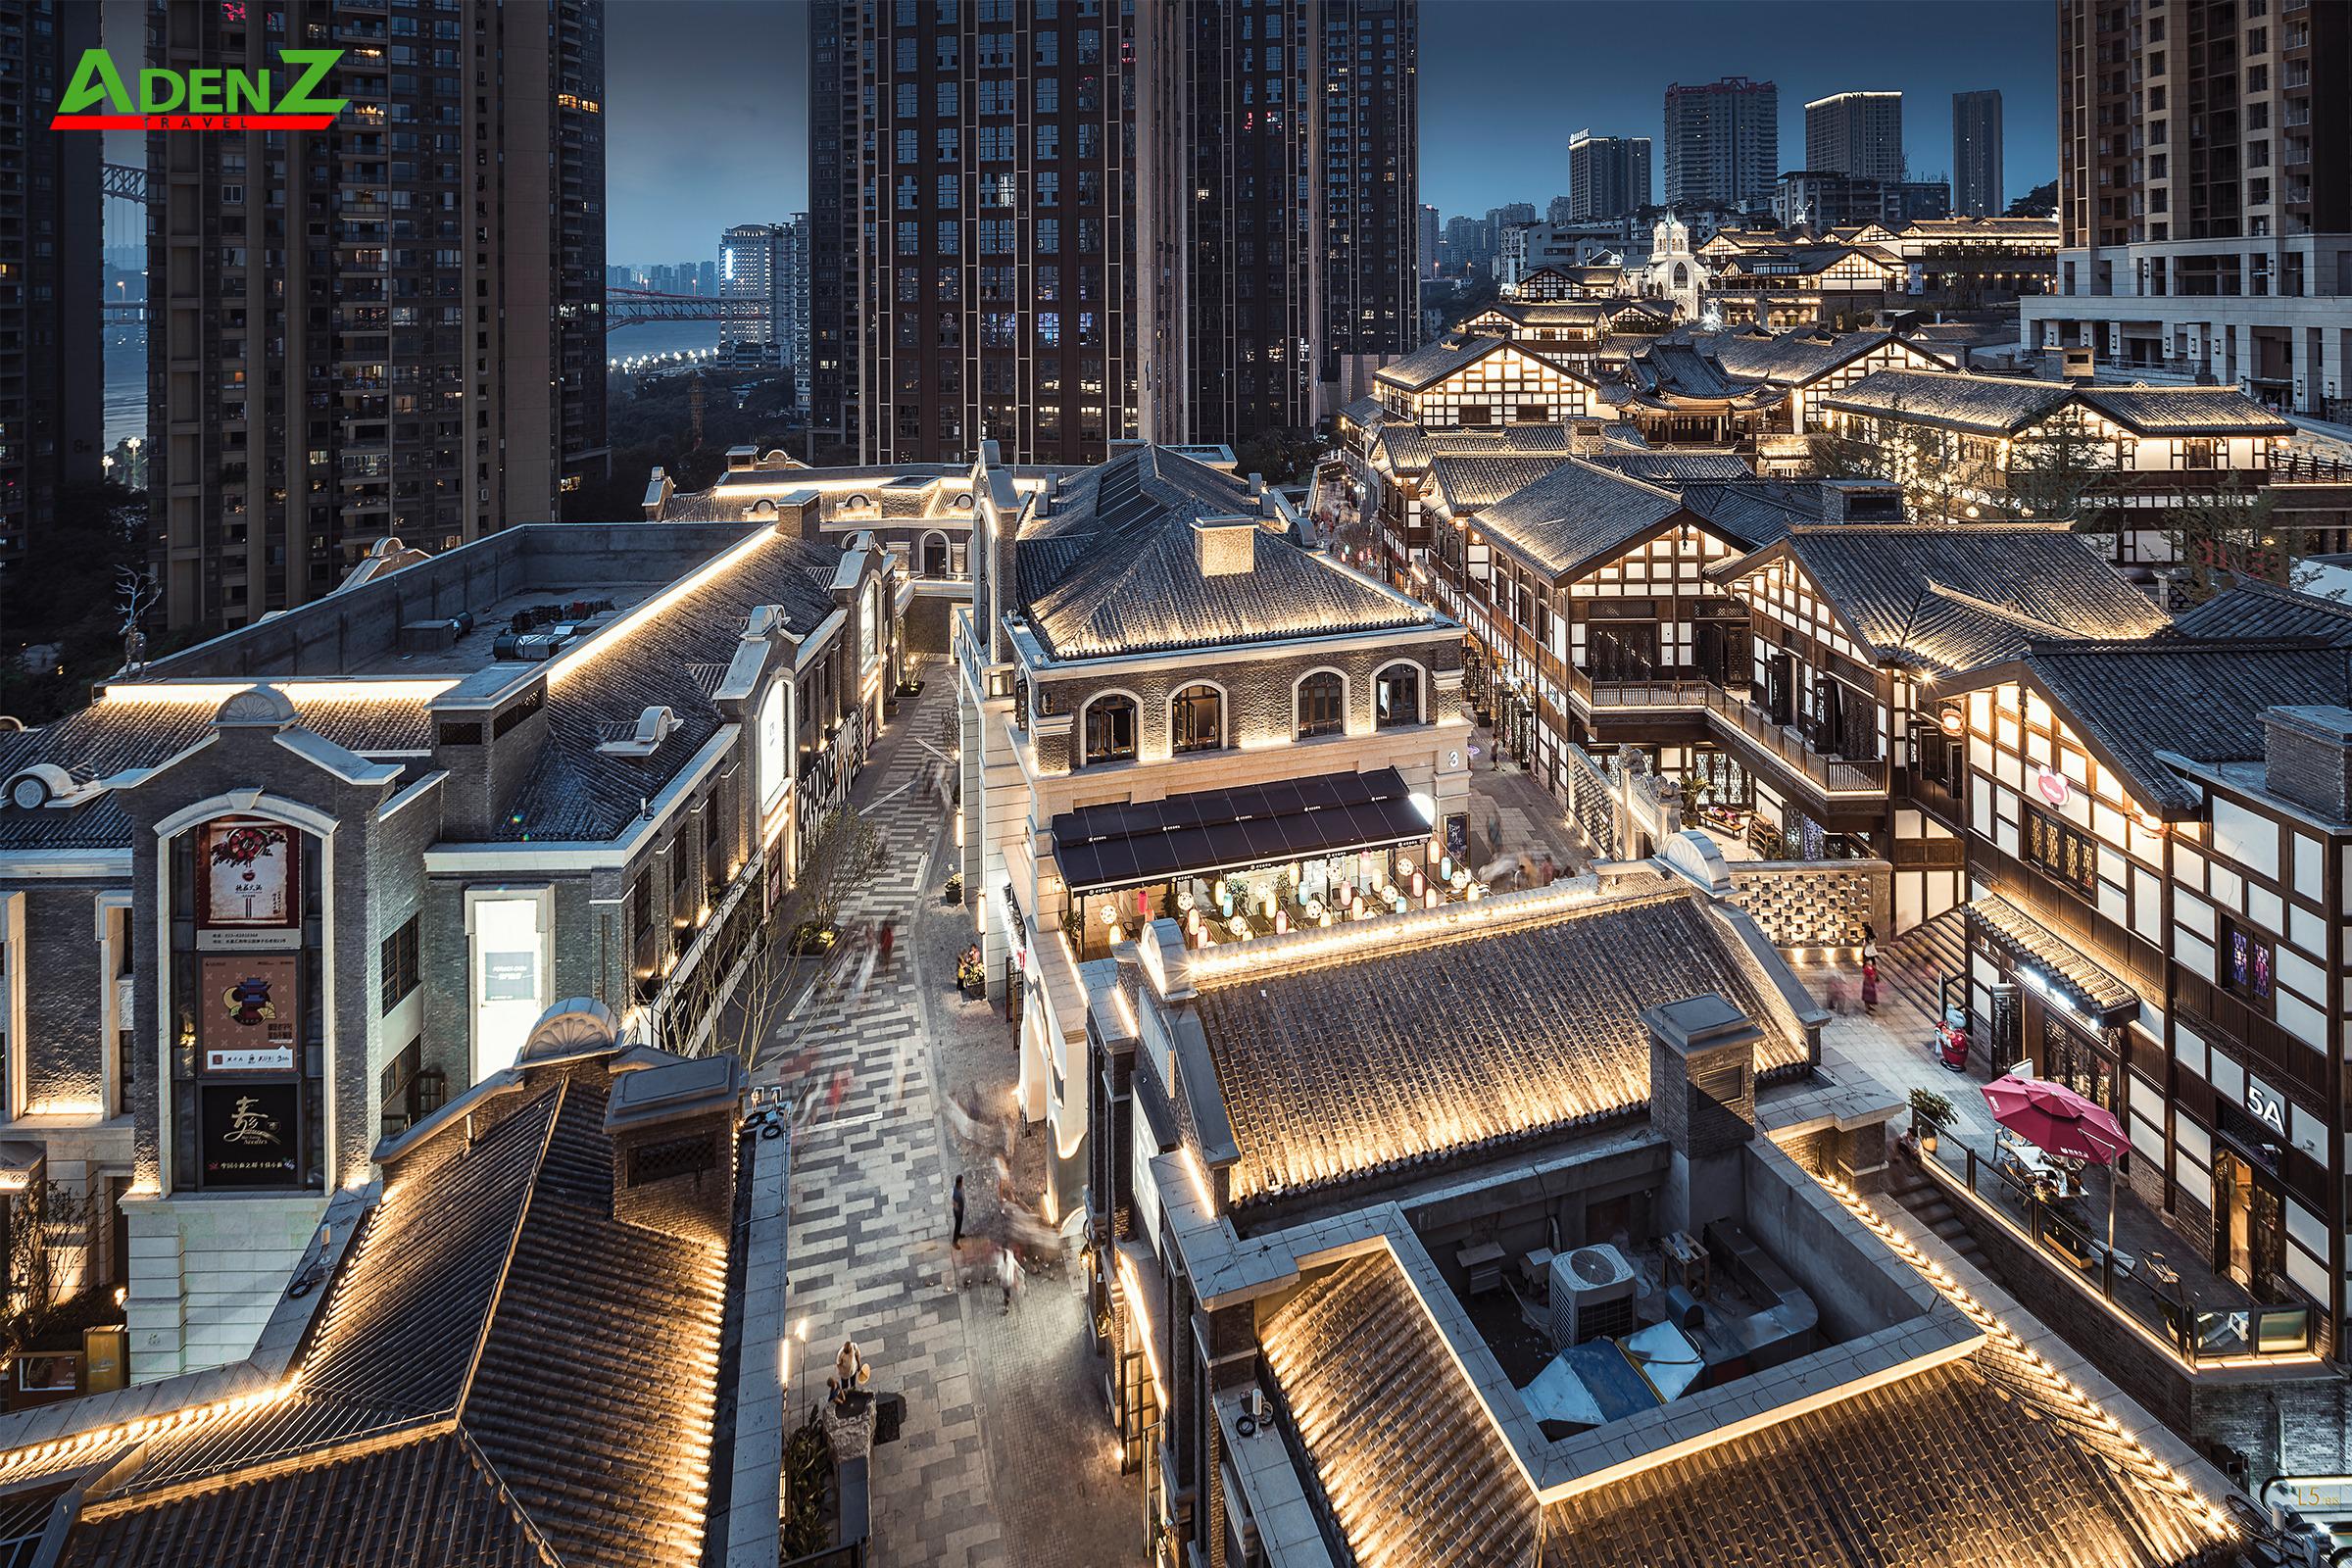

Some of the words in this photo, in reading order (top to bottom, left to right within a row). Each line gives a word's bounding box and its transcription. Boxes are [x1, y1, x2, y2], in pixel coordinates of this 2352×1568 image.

[1449, 751, 1459, 768] 3
[2247, 1085, 2285, 1137] 5A
[2298, 1487, 2320, 1506] L5
